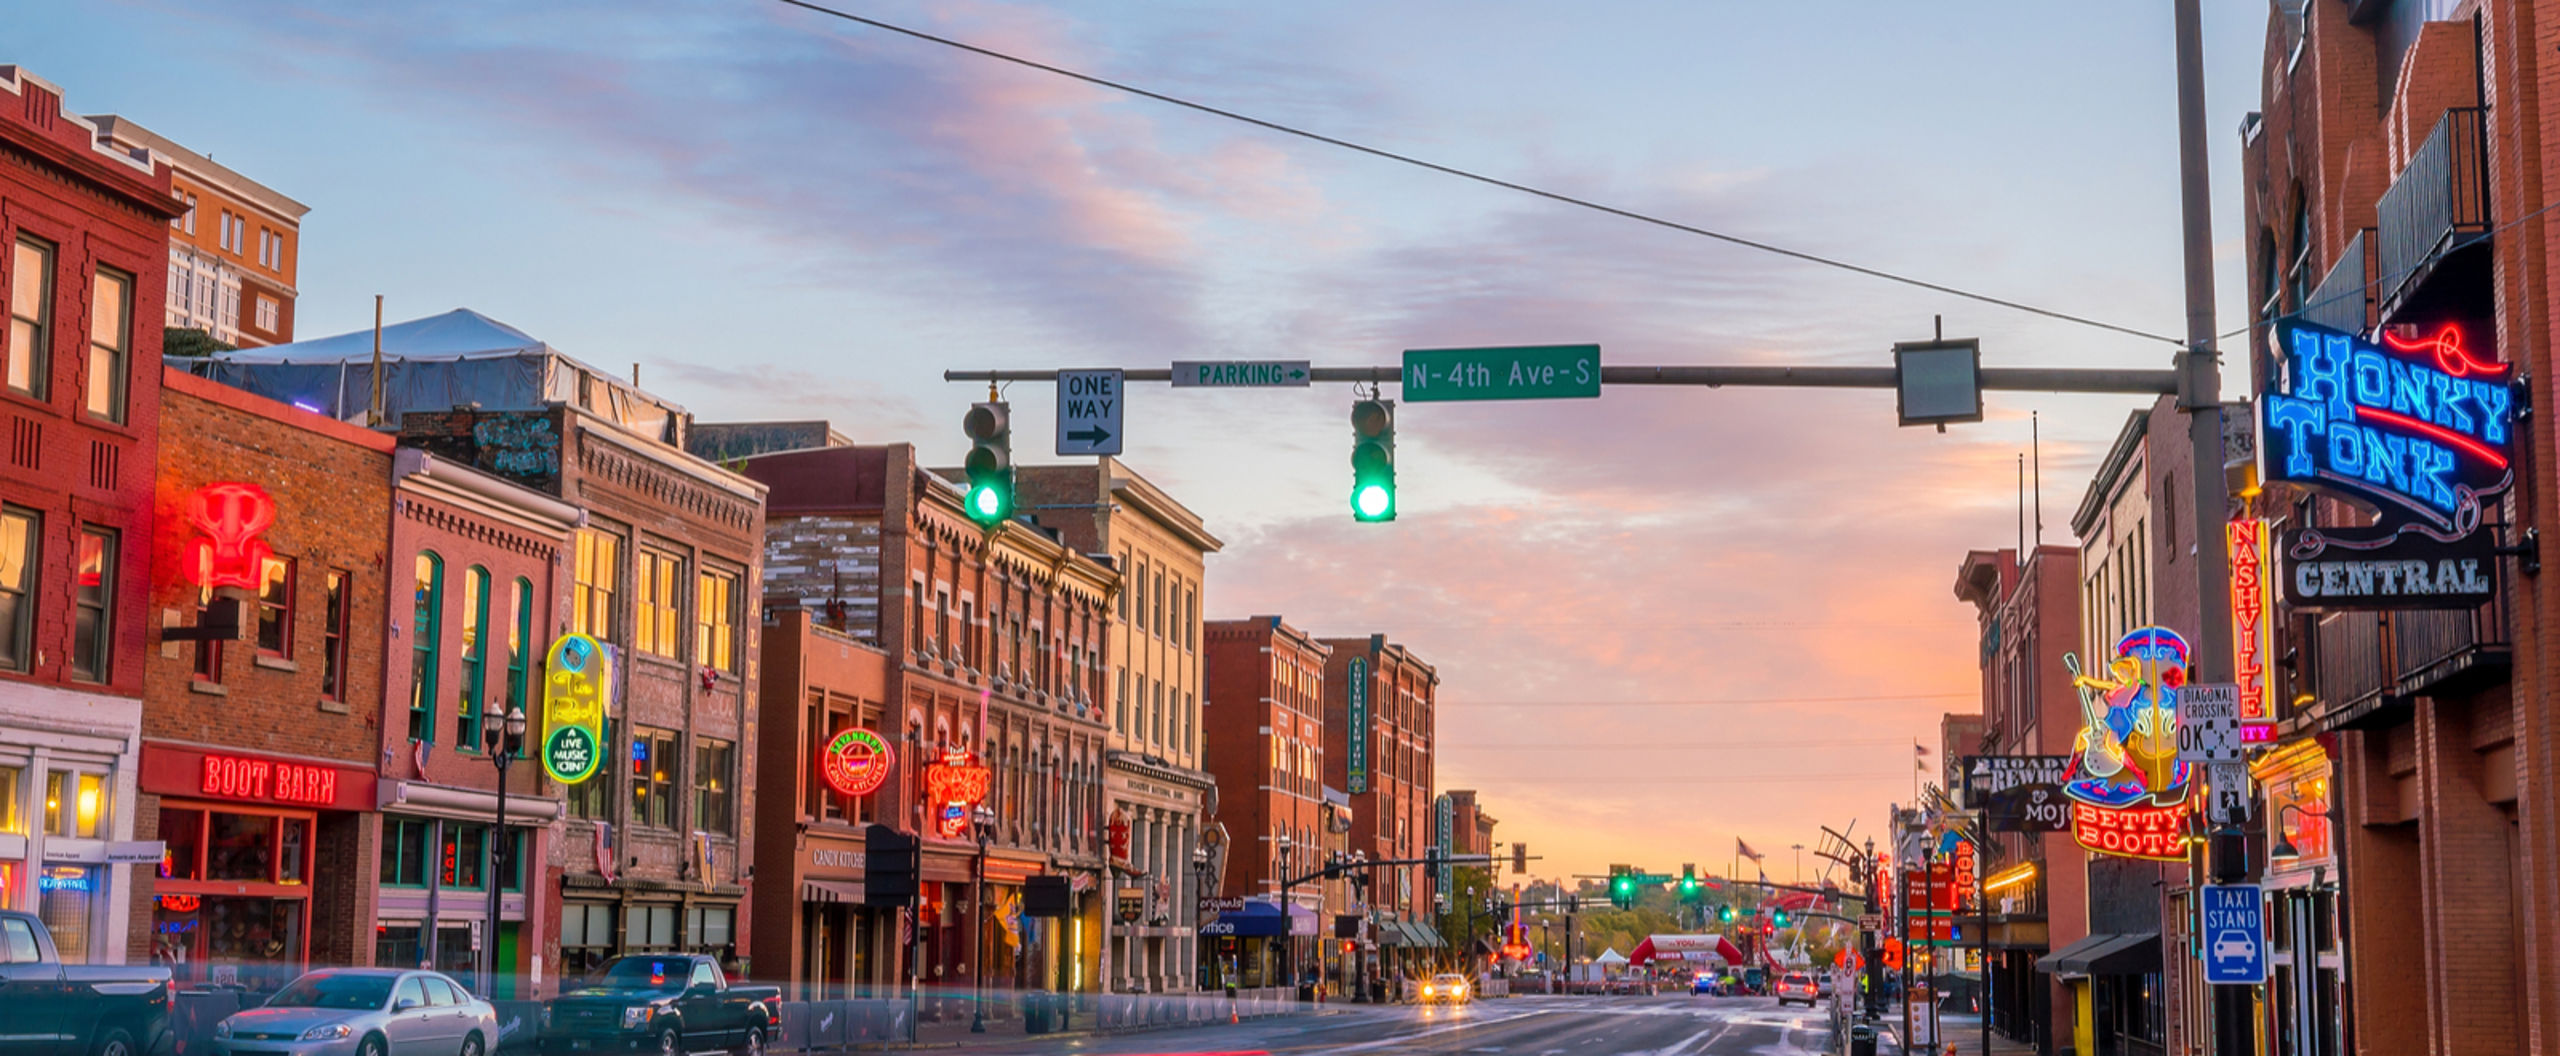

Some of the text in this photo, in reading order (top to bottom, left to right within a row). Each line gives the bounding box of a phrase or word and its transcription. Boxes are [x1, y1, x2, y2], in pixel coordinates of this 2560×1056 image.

[1199, 364, 1283, 385] PARKING
[1412, 358, 1590, 389] N-4th Ave-S
[1069, 376, 1112, 396] ONE
[2292, 327, 2508, 445] HONKY
[1068, 399, 1112, 419] WAY
[2269, 395, 2455, 513] TONK
[2295, 558, 2489, 597] CENTRAL
[2233, 519, 2263, 719] NASHVILLE
[2184, 689, 2234, 703] DIAGONAL
[2185, 704, 2234, 718] CROSSING
[567, 729, 577, 738] A
[2180, 724, 2204, 751] OK
[2241, 726, 2270, 741] ITY
[561, 739, 582, 749] LIVE
[553, 750, 588, 761] MUSIC
[556, 761, 586, 773] JOINT
[203, 755, 337, 806] BOOT BARN
[2223, 783, 2235, 791] ON
[2077, 802, 2186, 832] BETTY
[2080, 826, 2179, 854] BOOTS
[813, 848, 865, 868] CANDY KITCHE
[2217, 890, 2250, 909] TAXI
[2208, 910, 2257, 929] STAND
